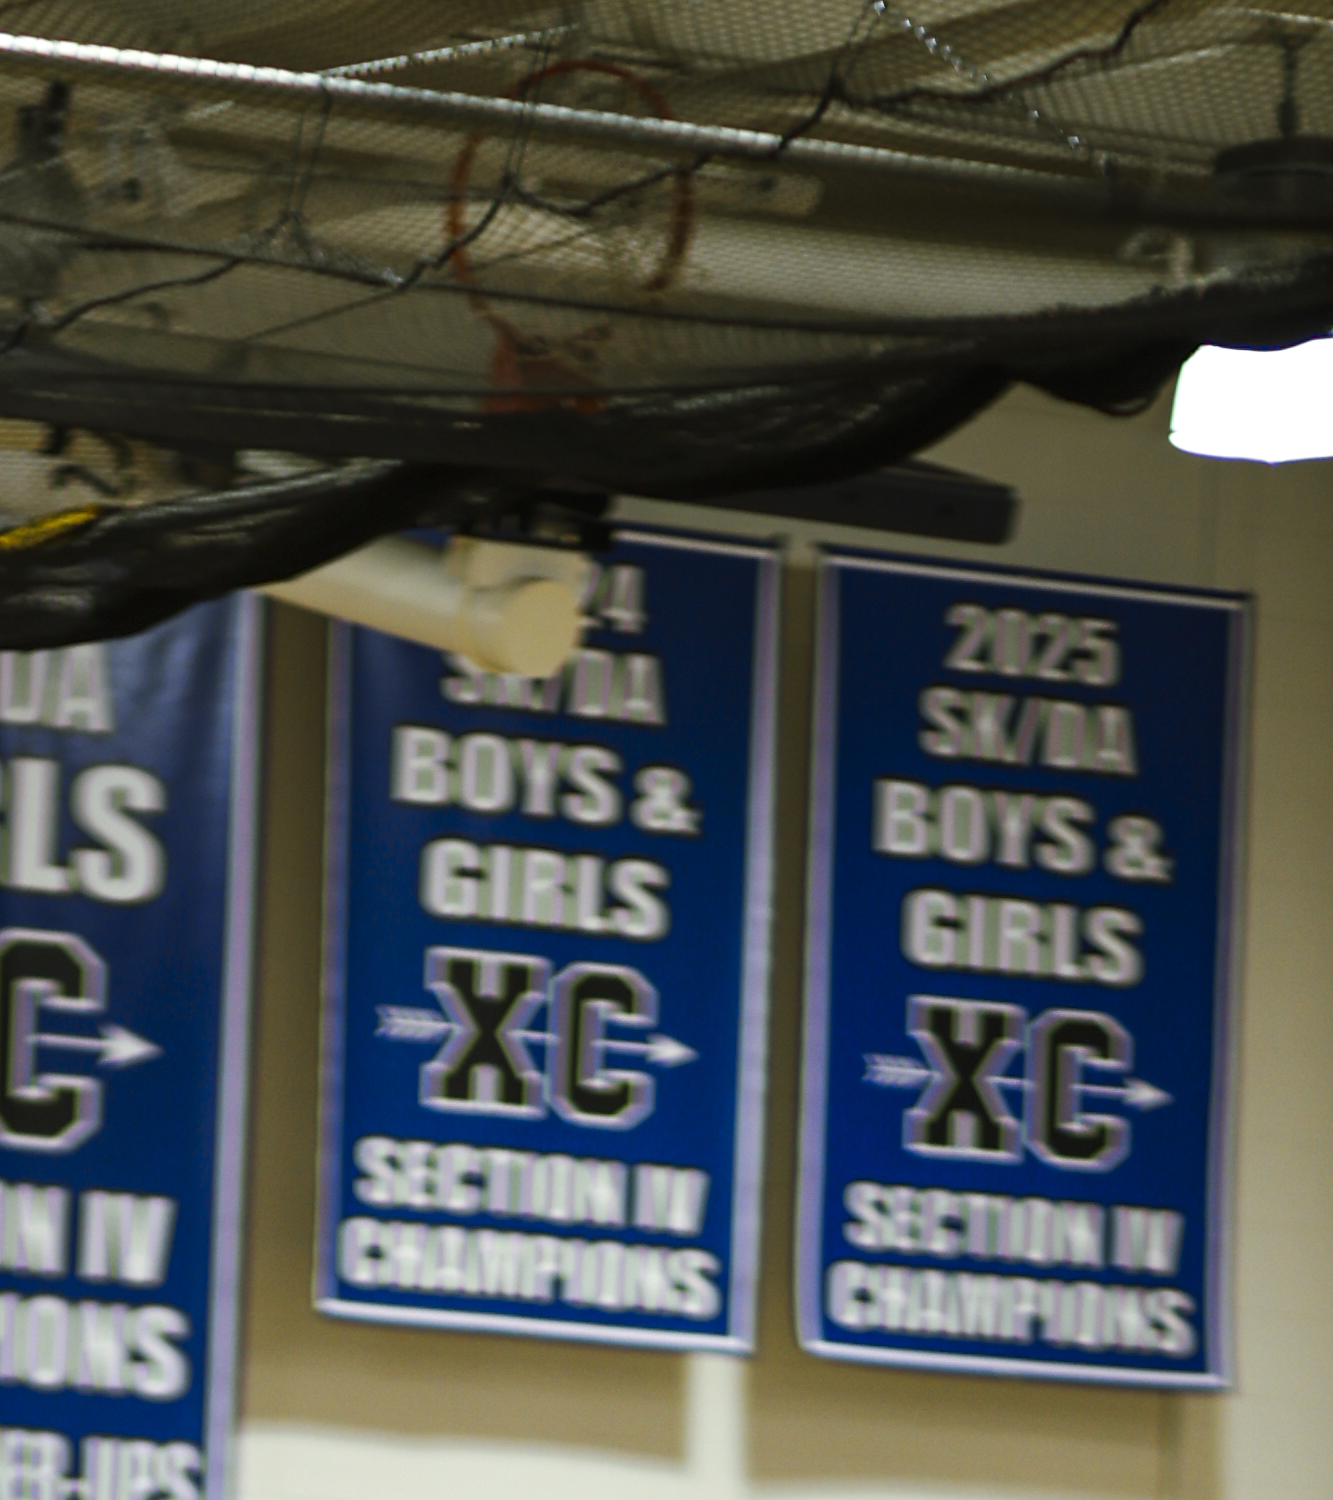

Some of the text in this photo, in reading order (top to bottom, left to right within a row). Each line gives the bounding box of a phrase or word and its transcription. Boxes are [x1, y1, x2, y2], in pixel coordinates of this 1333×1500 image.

[944, 605, 1120, 686] 2025
[391, 725, 703, 837] BOYS &
[919, 686, 1136, 776] SK/DA
[873, 778, 1175, 884] BOYS &
[419, 838, 671, 942] GIRLS
[901, 889, 1145, 988] GIRLS
[420, 946, 660, 1130] XC
[904, 994, 1131, 1173] XC
[354, 1135, 710, 1238] SECTION IV
[845, 1181, 1184, 1277] SECTION IV
[77, 1190, 176, 1291] IV
[339, 1217, 721, 1321] CHAMPIONS
[827, 1260, 1196, 1357] CHAMPIONS
